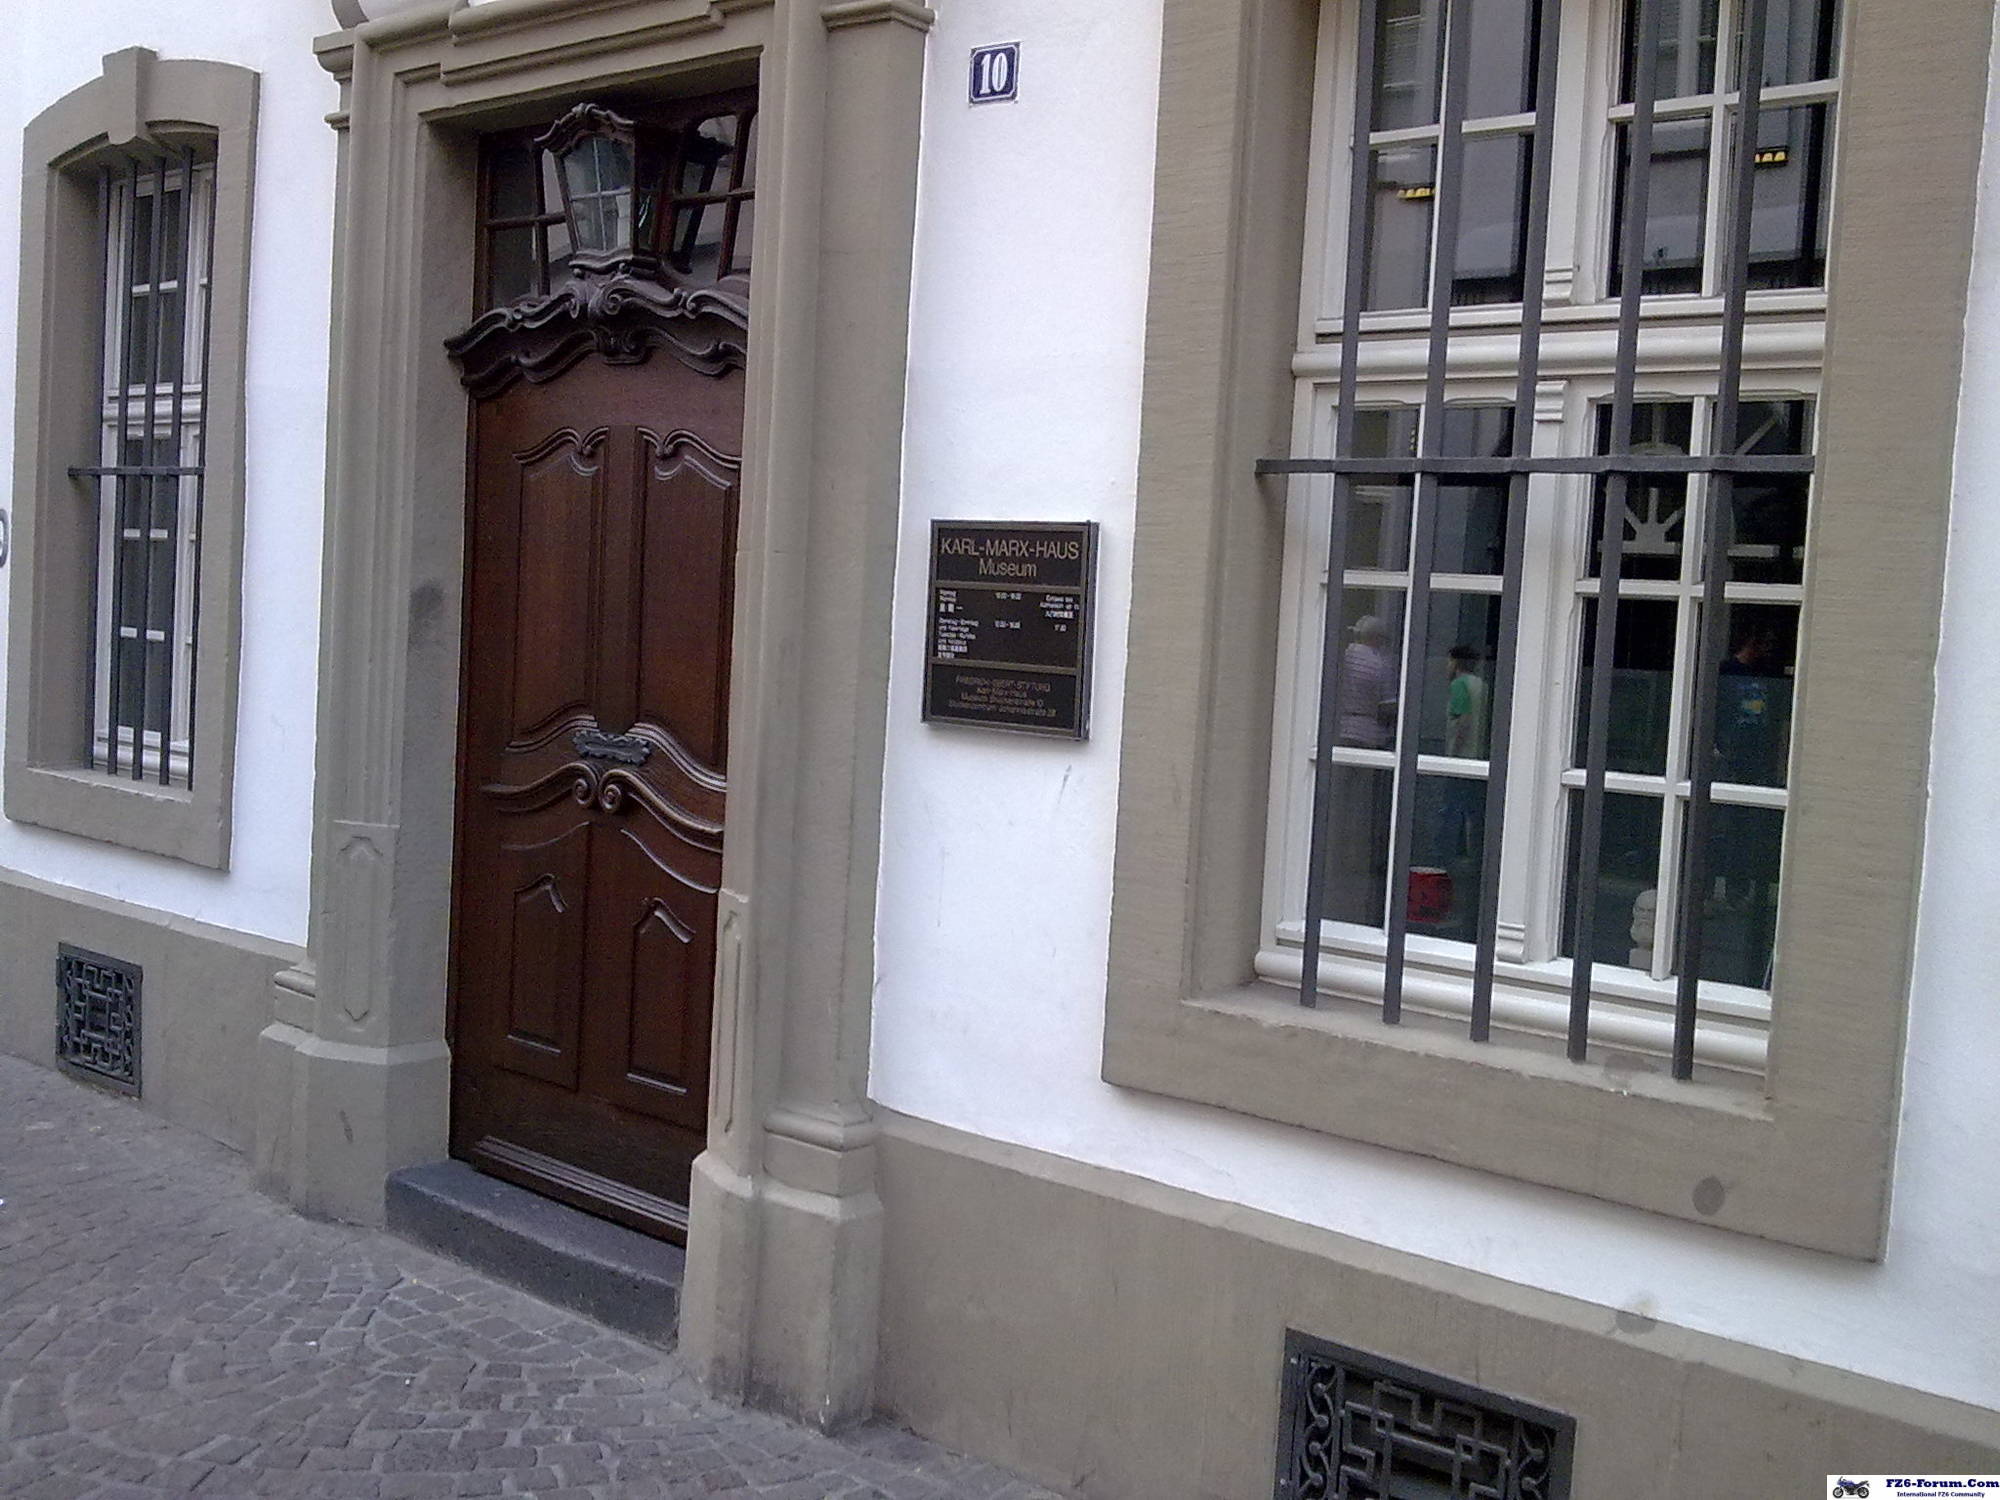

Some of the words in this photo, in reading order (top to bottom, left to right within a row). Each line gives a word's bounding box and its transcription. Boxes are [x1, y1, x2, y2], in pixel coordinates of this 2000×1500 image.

[979, 52, 1008, 94] 10
[940, 537, 1080, 560] KARL-MARX-HAUS
[978, 558, 1037, 577] Museum
